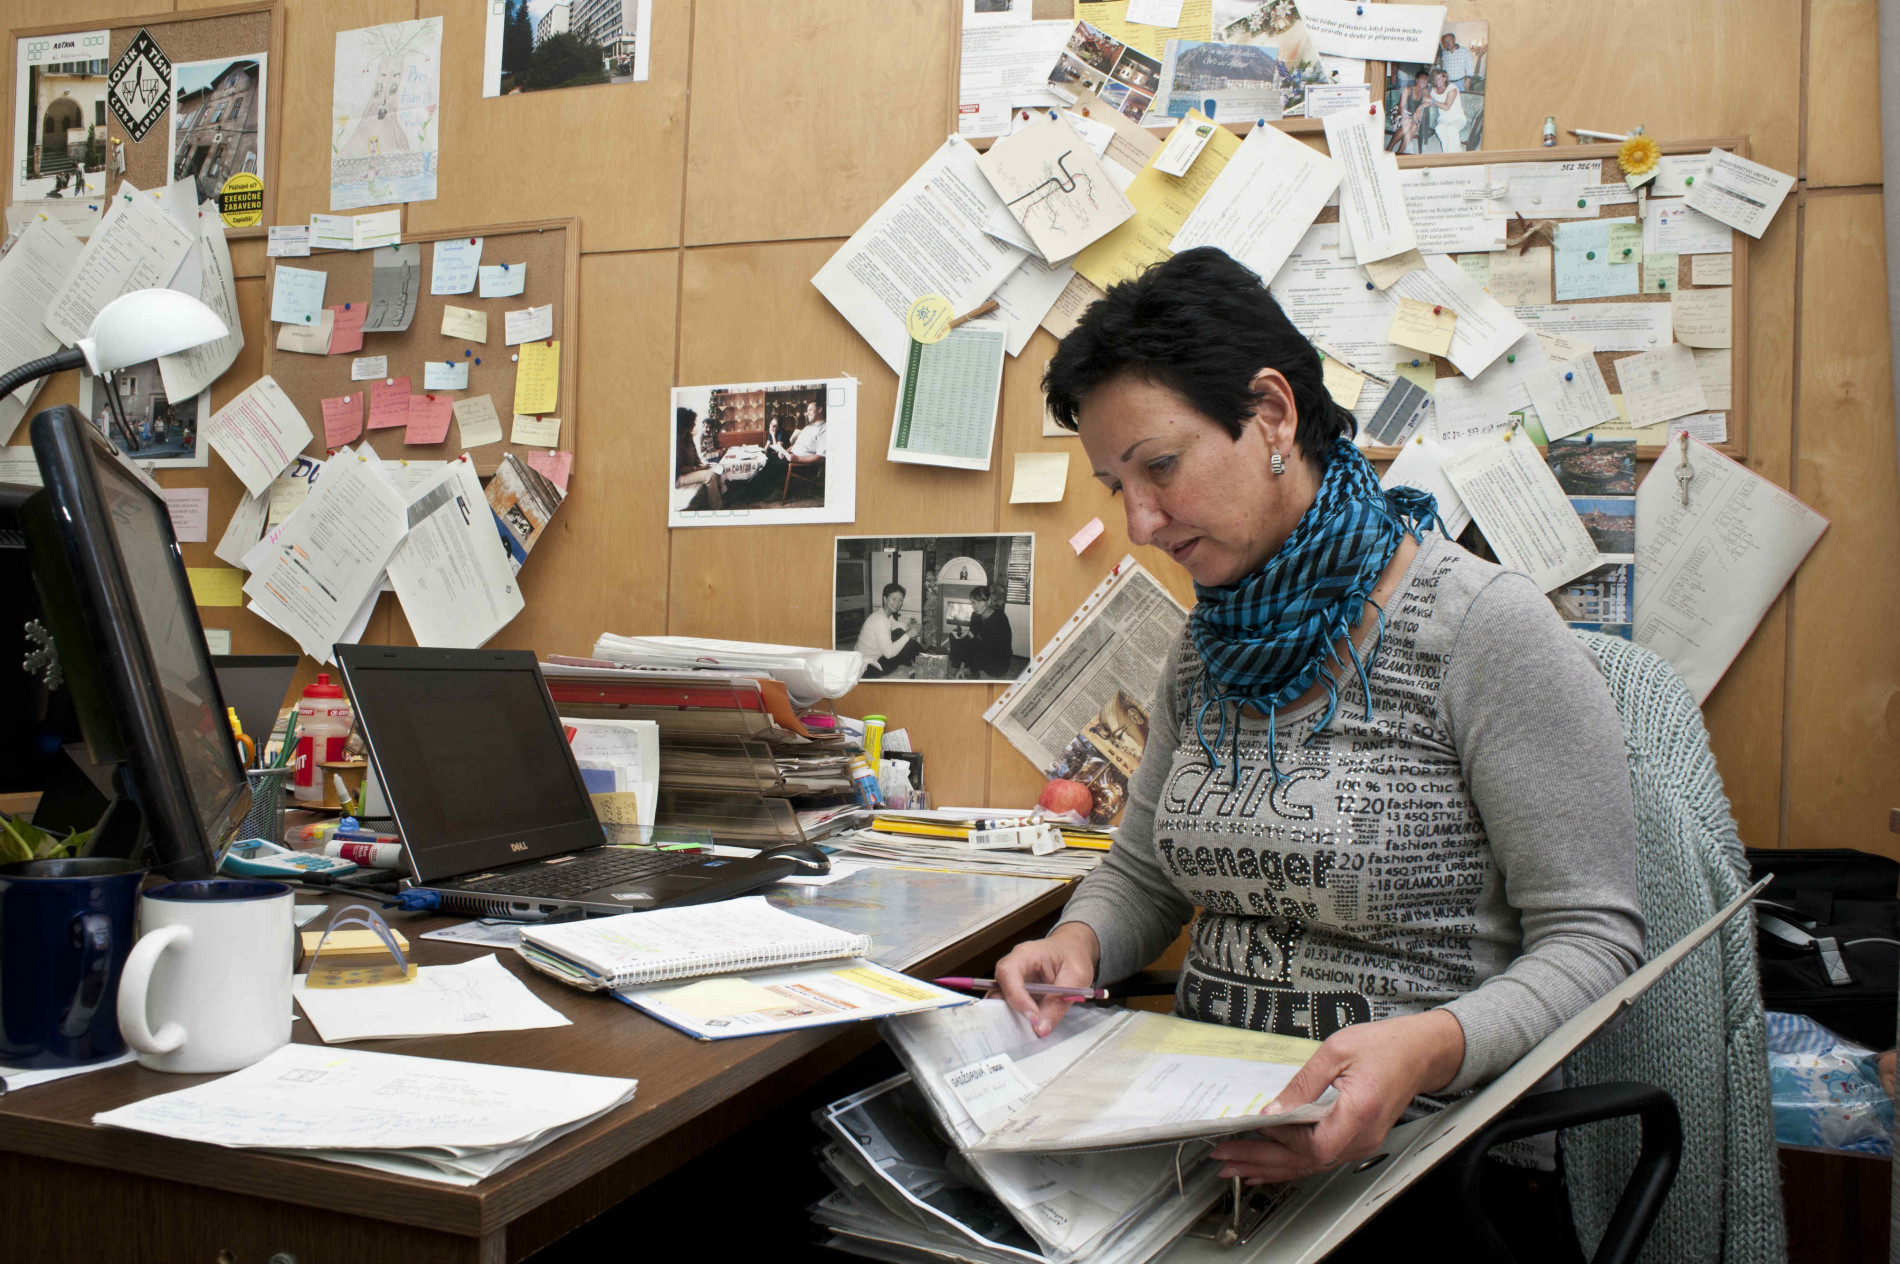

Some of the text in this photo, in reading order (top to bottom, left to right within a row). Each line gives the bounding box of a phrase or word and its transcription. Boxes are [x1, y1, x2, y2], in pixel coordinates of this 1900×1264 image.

[108, 48, 138, 91] LOVĚK
[139, 40, 147, 50] V
[224, 202, 262, 212] ZABAVENO
[1412, 576, 1440, 588] DANCE
[1416, 652, 1440, 663] URBAN
[1421, 664, 1441, 680] DOLL
[1416, 680, 1440, 691] FEVER
[1382, 698, 1397, 712] the
[1377, 719, 1406, 731] OFF
[1352, 740, 1394, 752] DANCE
[1400, 766, 1430, 776] POP
[1164, 762, 1330, 821] CHIC
[1366, 781, 1380, 793] %
[1386, 782, 1416, 794] 100
[1421, 781, 1453, 794] chic
[1334, 795, 1443, 815] 12.20 fashion
[1432, 811, 1462, 822] STYLE
[511, 842, 528, 852] DELL
[1386, 840, 1438, 850] fashion
[1368, 852, 1423, 865] fashion
[1160, 838, 1333, 892] Teenager
[1412, 864, 1441, 874] STYLE
[1446, 862, 1484, 872] URBAN
[1457, 873, 1484, 886] DOLL
[1454, 887, 1482, 896] FEVER
[1400, 910, 1412, 922] all
[1414, 908, 1431, 921] the
[1398, 961, 1435, 981] WORLD
[1436, 970, 1474, 986] DANCE
